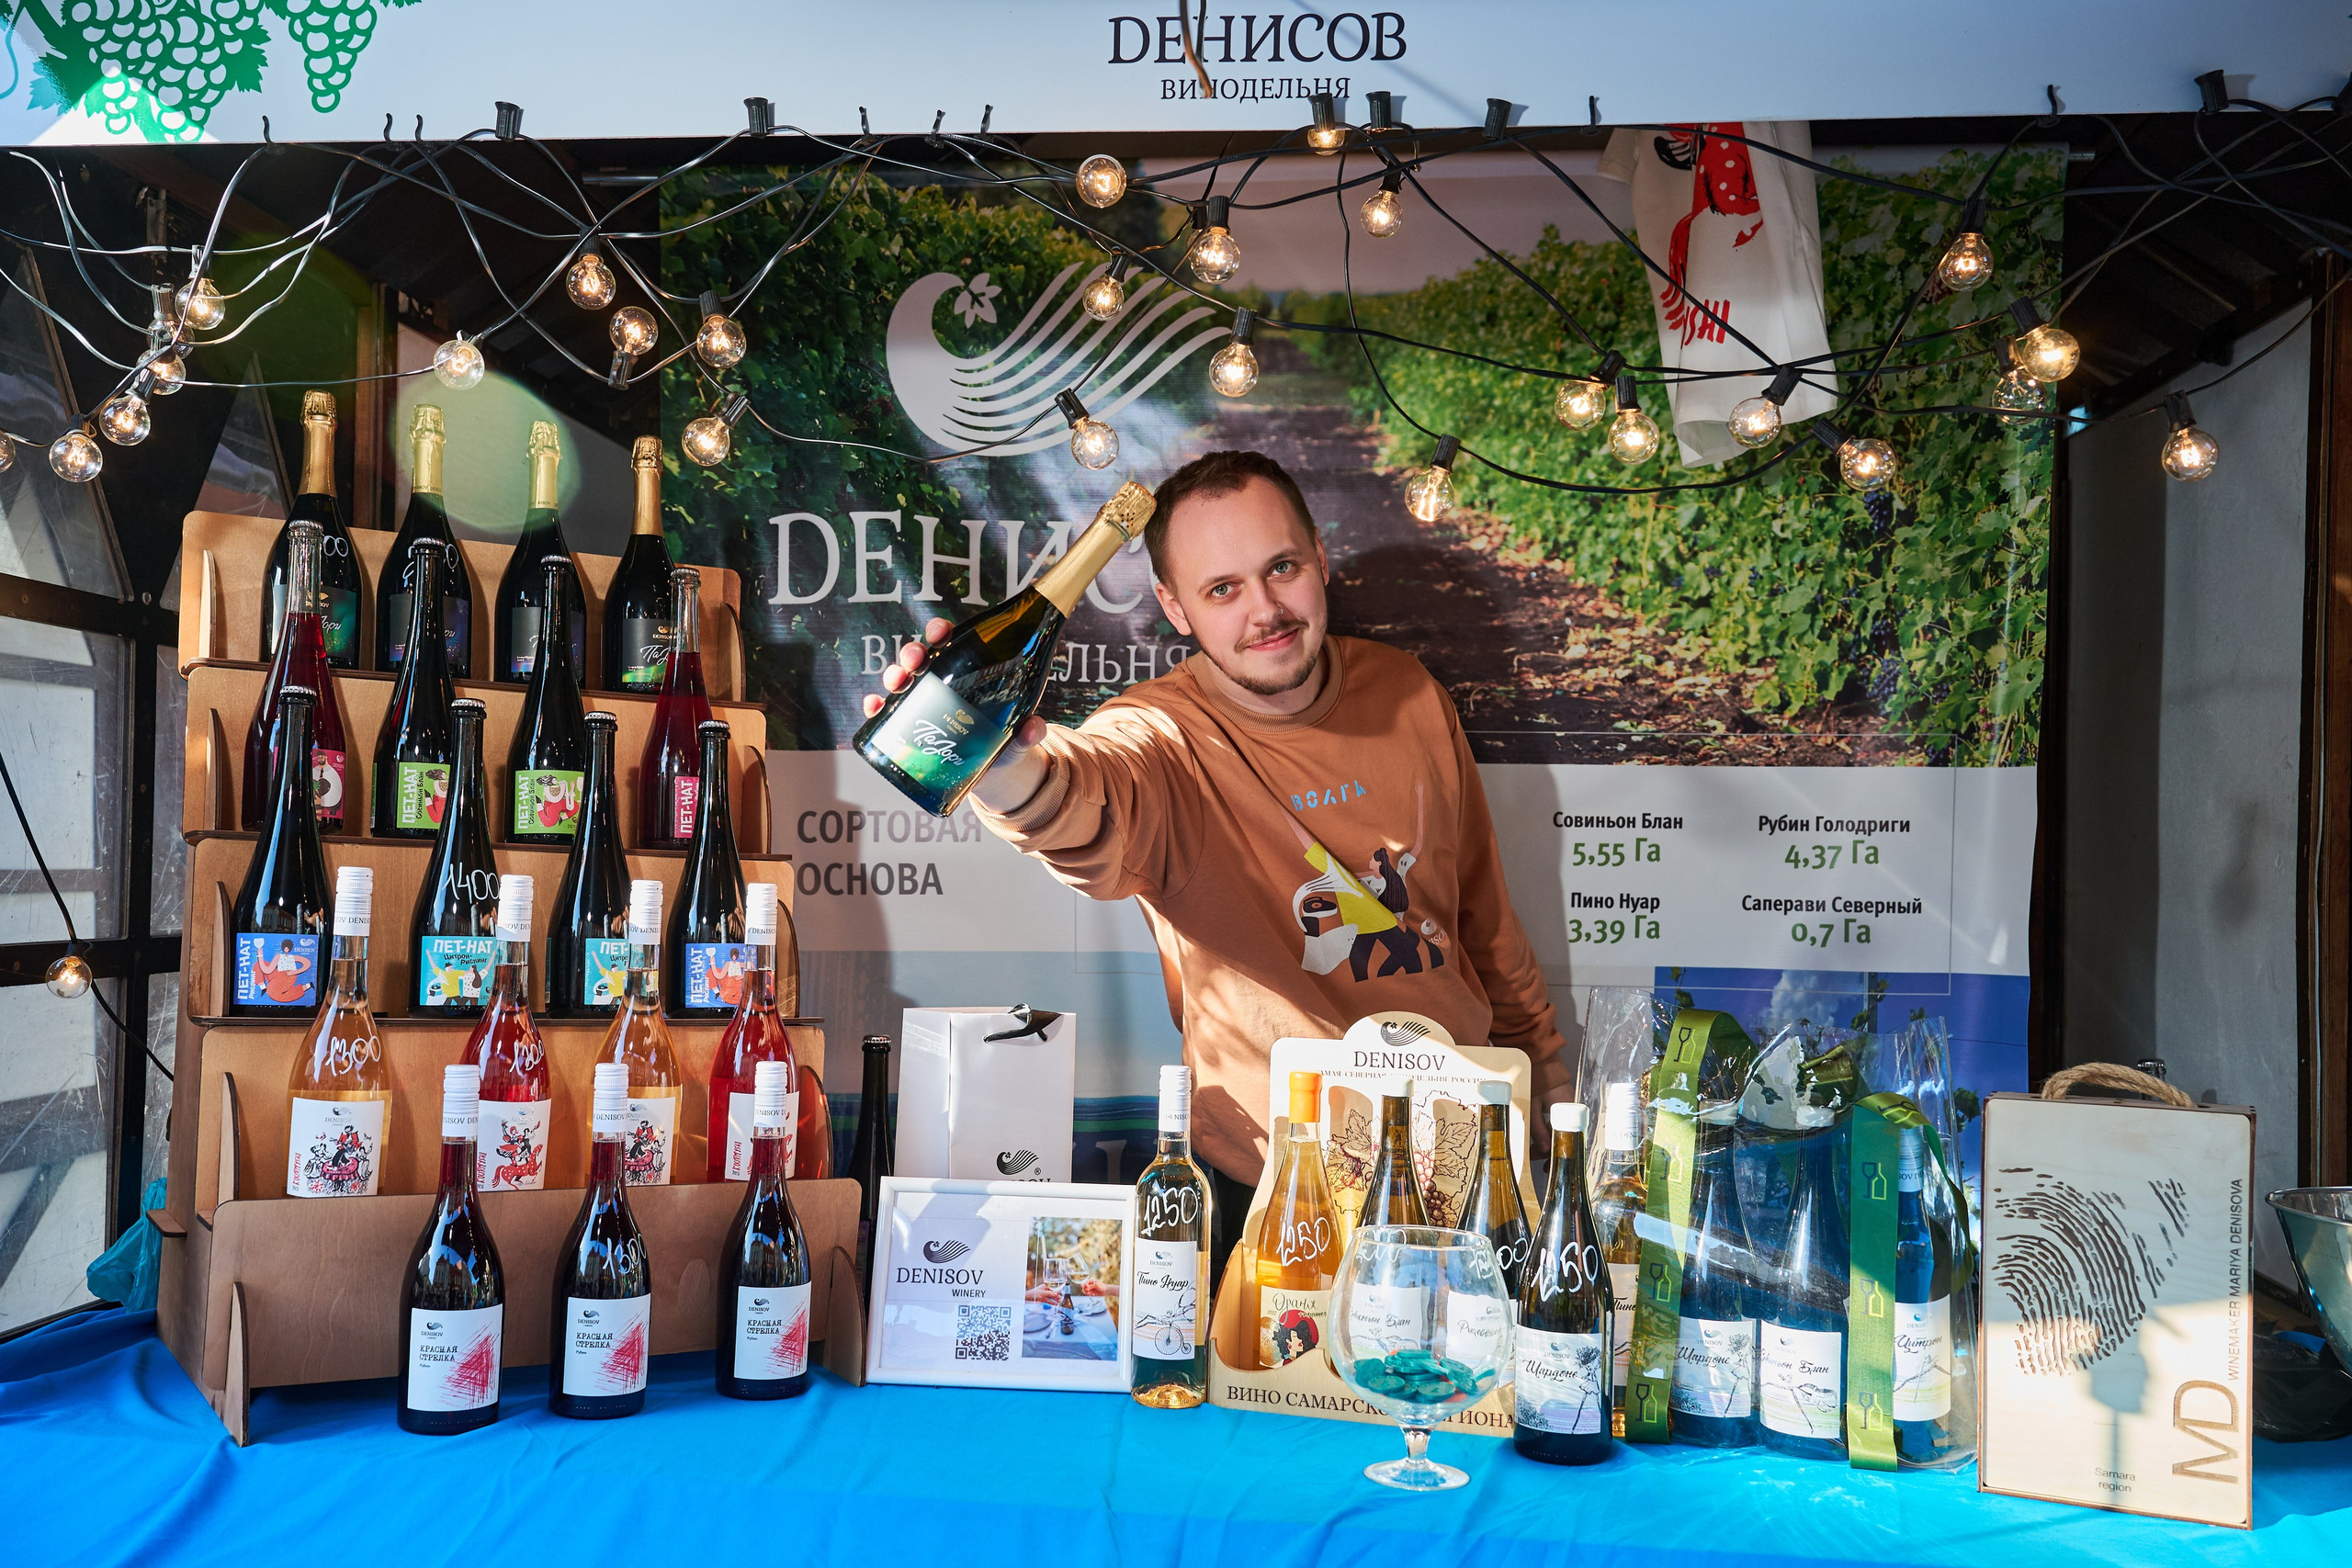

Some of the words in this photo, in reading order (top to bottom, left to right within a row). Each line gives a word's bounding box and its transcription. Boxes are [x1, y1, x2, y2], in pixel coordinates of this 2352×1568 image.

[1160, 77, 1351, 104] ВИНОДЕЛЬНЯ
[402, 766, 417, 823] ПЕТ-НАТ
[517, 774, 529, 829] ПЕТ-НАТ
[680, 780, 694, 833] ПЕТ-НАТ
[797, 808, 982, 844] СОРТОВАЯ
[1553, 812, 1636, 829] Совиньон
[1641, 813, 1683, 829] Блан
[1758, 815, 1810, 835] Рубин
[1815, 816, 1911, 837] Голодриги
[1572, 842, 1625, 867] 5,55
[1634, 838, 1661, 863] Га
[1784, 844, 1843, 869] 4,37
[1851, 840, 1879, 865] Га
[442, 862, 500, 904] 1400
[797, 862, 944, 897] ОСНОВА
[1570, 893, 1614, 908] Пино
[1619, 893, 1660, 914] Нуар
[1742, 895, 1826, 917] Саперави
[1831, 897, 1922, 915] Северный
[1568, 918, 1625, 943] 3,39
[1634, 915, 1661, 940] Га
[1791, 922, 1834, 948] 0,7
[1843, 919, 1871, 943] Га
[434, 939, 493, 953] ПЕТ-НАТ
[600, 942, 628, 954] ПЕТ-
[237, 937, 252, 999] ПЕТ-НАТ
[690, 947, 703, 1004] ПЕТ-НАТ
[324, 1035, 381, 1077] 1300
[1353, 1051, 1445, 1071] DENISOV
[1316, 1069, 1341, 1077] АМАЯ
[444, 1116, 466, 1124] NISOV
[1141, 1186, 1198, 1237] 1250
[2230, 1179, 2243, 1244] DENISOVA
[1275, 1216, 1331, 1267] 1250
[896, 1267, 984, 1285] DENISOV
[1137, 1270, 1159, 1286] Пино
[1531, 1241, 1598, 1303] 1250
[2230, 1247, 2242, 1297] MARIYA
[952, 1289, 987, 1298] WINERY
[576, 1332, 614, 1340] КРАСНАЯ
[576, 1340, 611, 1348] СТРЕЛКА
[1894, 1334, 1943, 1354] Цитрон
[2228, 1301, 2241, 1381] WINEMAKER
[420, 1345, 458, 1353] КРАСНАЯ
[420, 1353, 456, 1361] СТРЕЛКА
[1676, 1345, 1731, 1368] Шардоне
[1522, 1359, 1578, 1382] Шардоне
[1799, 1359, 1830, 1375] Блан
[1227, 1385, 1282, 1404] ВИНО
[2172, 1380, 2240, 1484] MD
[2095, 1468, 2136, 1482] Samara
[2098, 1480, 2132, 1494] region
